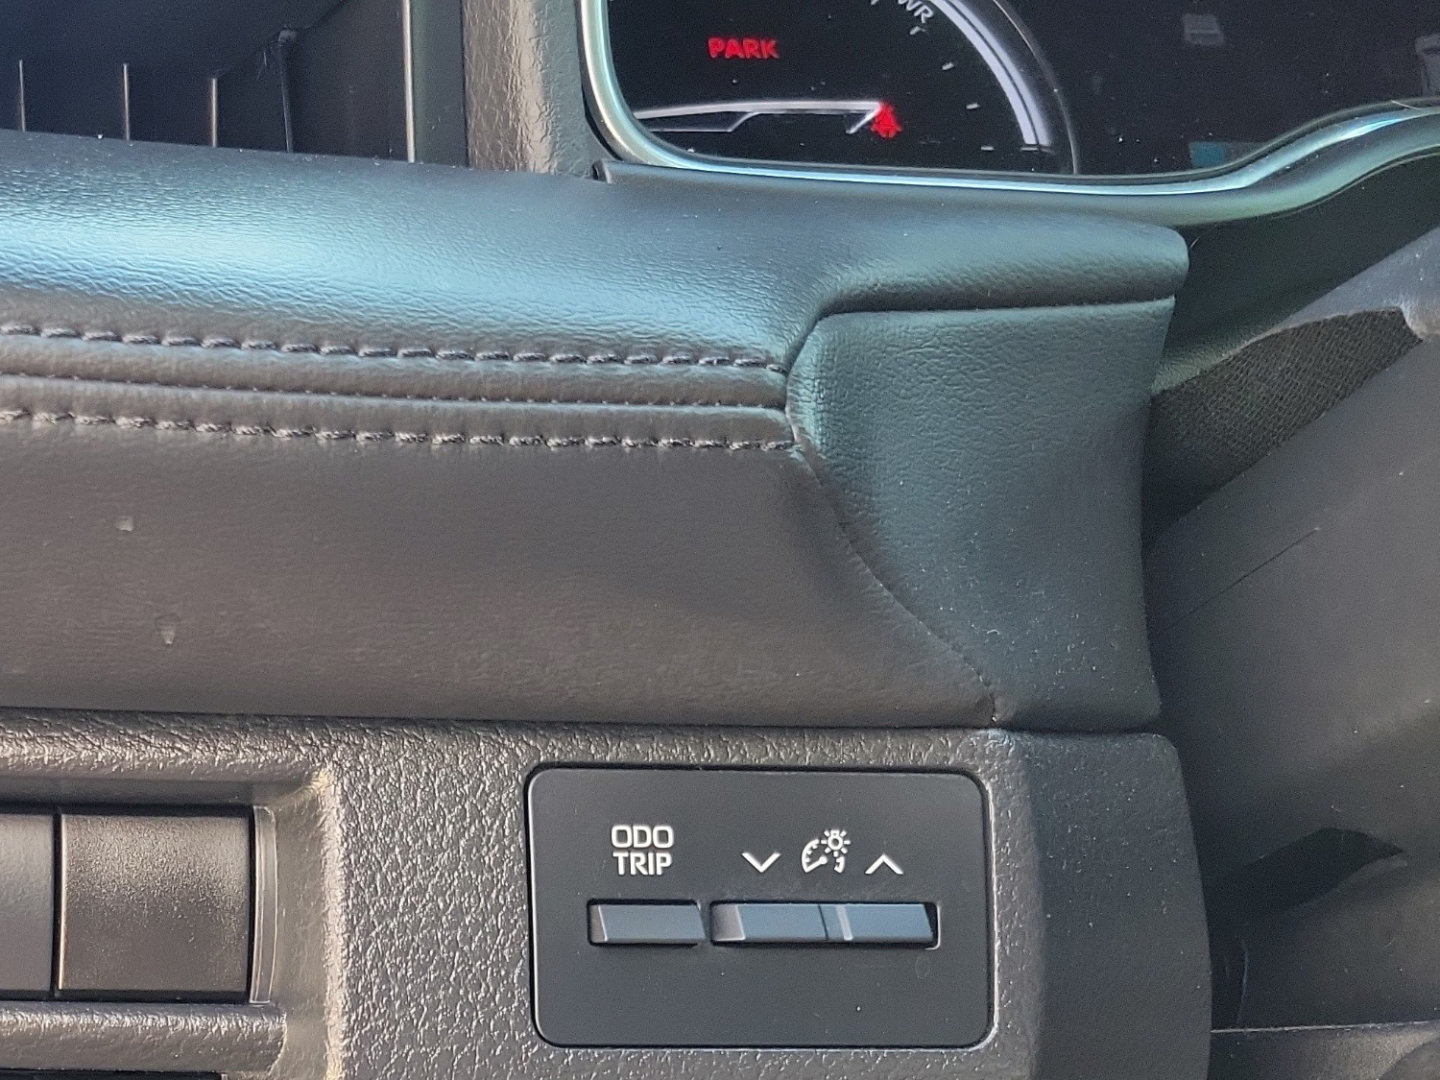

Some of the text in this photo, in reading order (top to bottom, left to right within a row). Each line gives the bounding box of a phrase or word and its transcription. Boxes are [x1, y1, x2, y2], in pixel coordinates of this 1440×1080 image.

[898, 0, 934, 24] WR
[707, 37, 780, 59] PARK
[611, 824, 674, 849] ODO
[612, 851, 672, 876] TRIP
